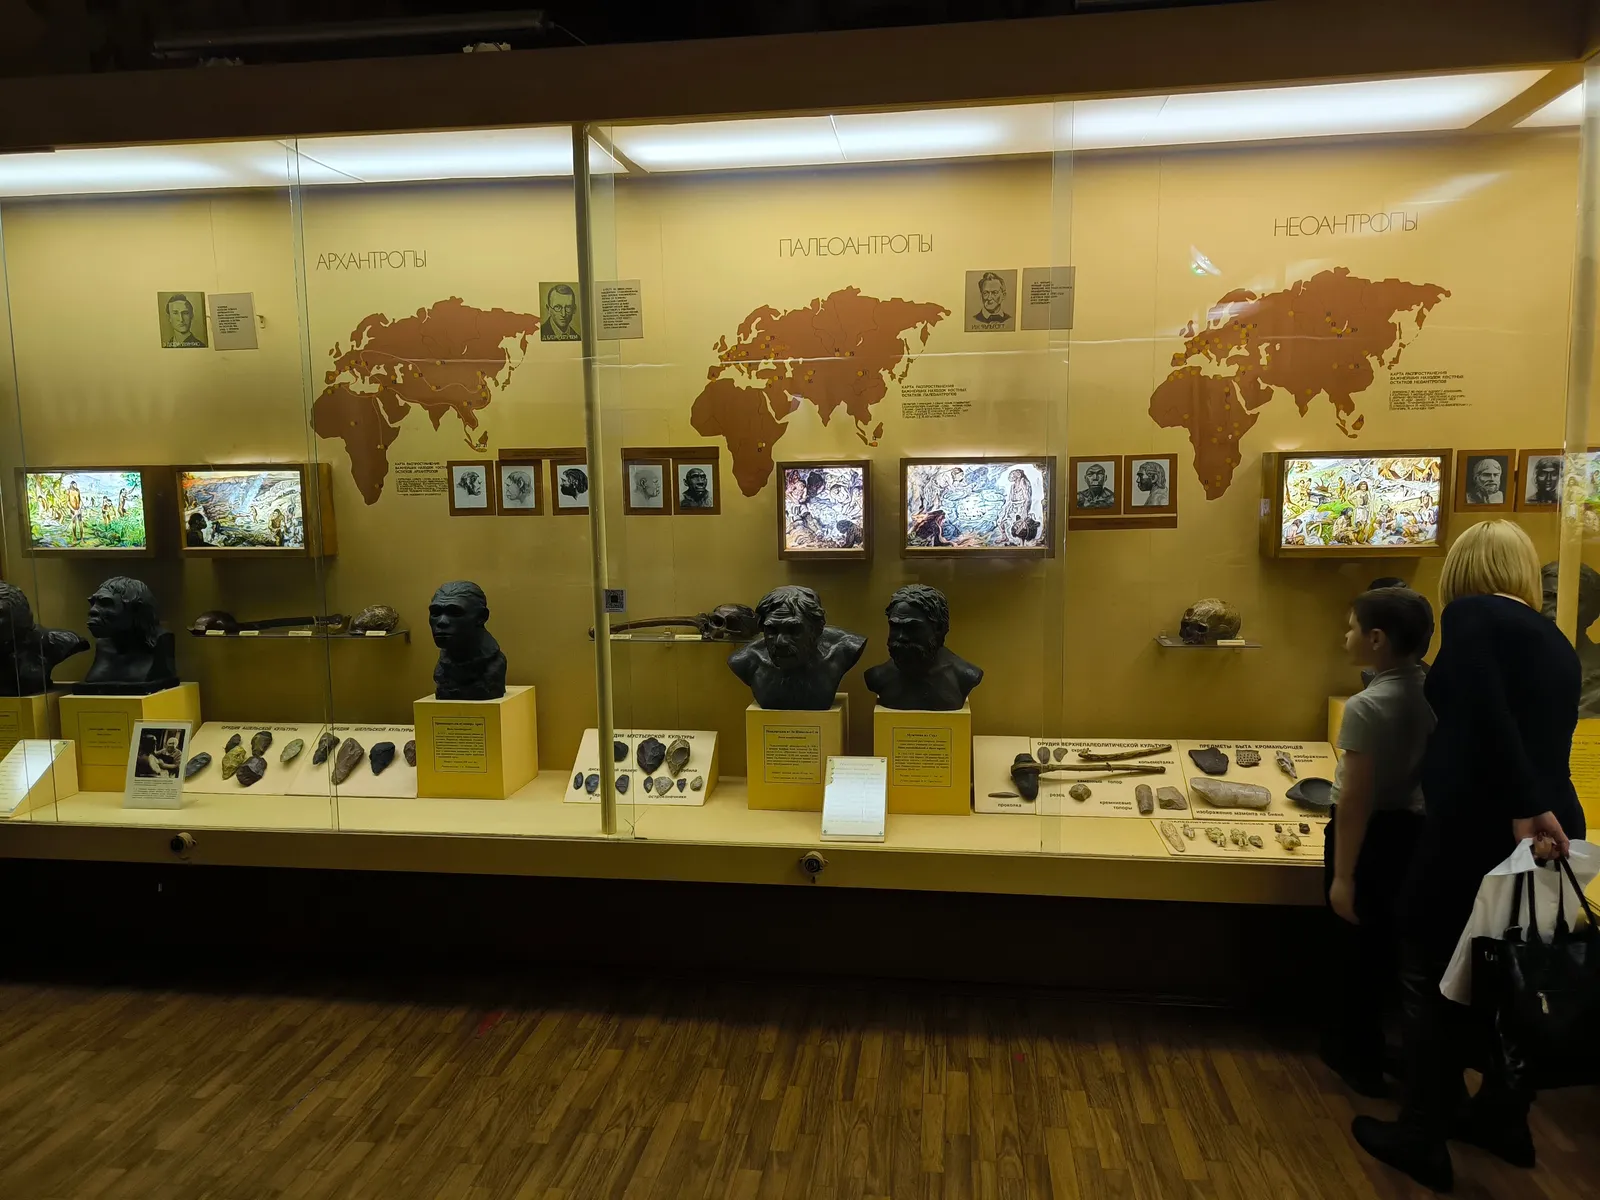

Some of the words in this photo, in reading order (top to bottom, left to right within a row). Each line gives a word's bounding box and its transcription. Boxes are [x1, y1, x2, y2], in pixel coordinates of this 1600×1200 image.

[1273, 211, 1419, 237] НЕОАНТРОПЫ
[779, 233, 933, 258] ПАЛЕОАНТРОПЫ
[315, 249, 427, 271] АРХАНТРОПЫ
